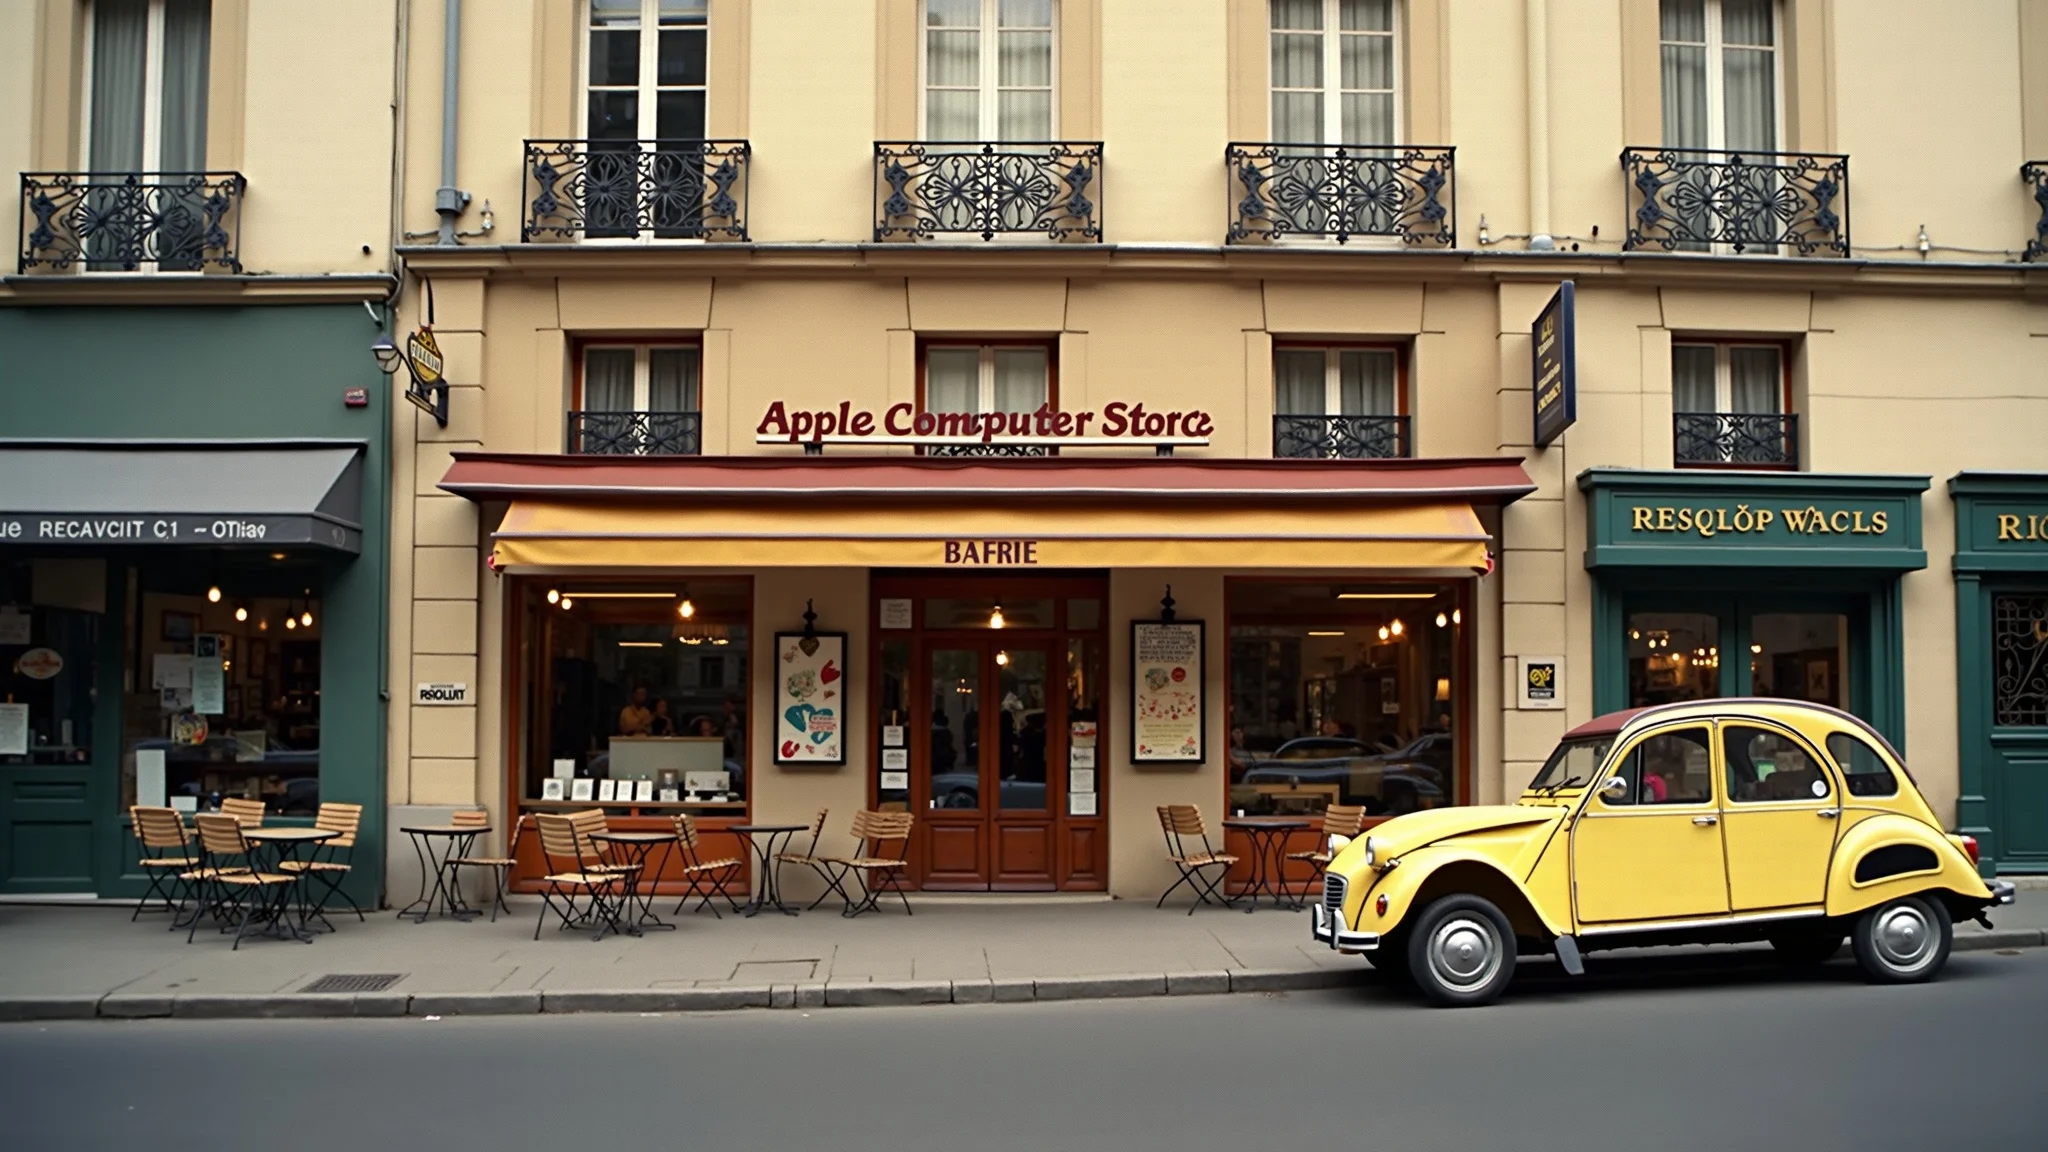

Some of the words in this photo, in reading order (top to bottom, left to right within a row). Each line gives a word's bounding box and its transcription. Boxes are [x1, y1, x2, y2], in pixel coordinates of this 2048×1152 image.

[756, 401, 876, 443] Apple
[884, 402, 1094, 443] Computer
[945, 541, 1037, 564] BAFRIE
